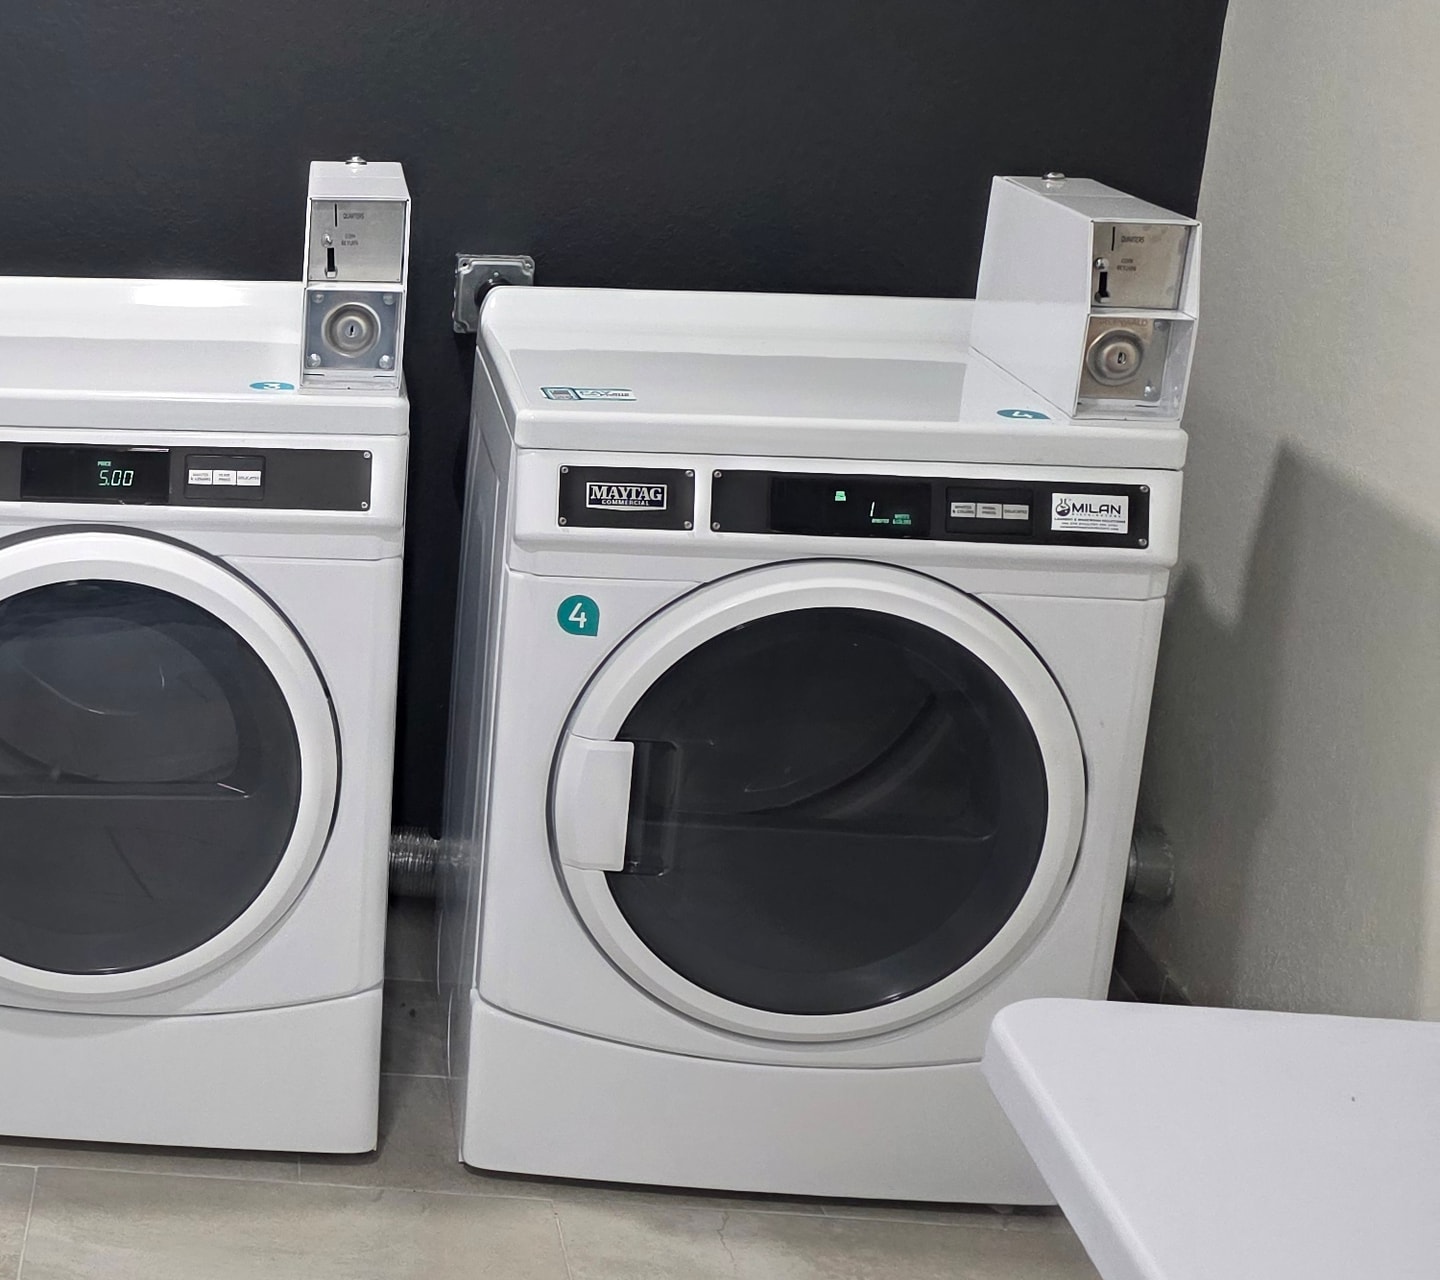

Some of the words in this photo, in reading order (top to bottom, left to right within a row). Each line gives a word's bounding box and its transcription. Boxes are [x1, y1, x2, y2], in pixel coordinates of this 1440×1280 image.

[1012, 411, 1033, 419] 4
[98, 470, 134, 486] 5.00
[590, 485, 663, 501] MAYTAG
[1072, 502, 1122, 515] MILAN
[568, 602, 587, 629] 4
